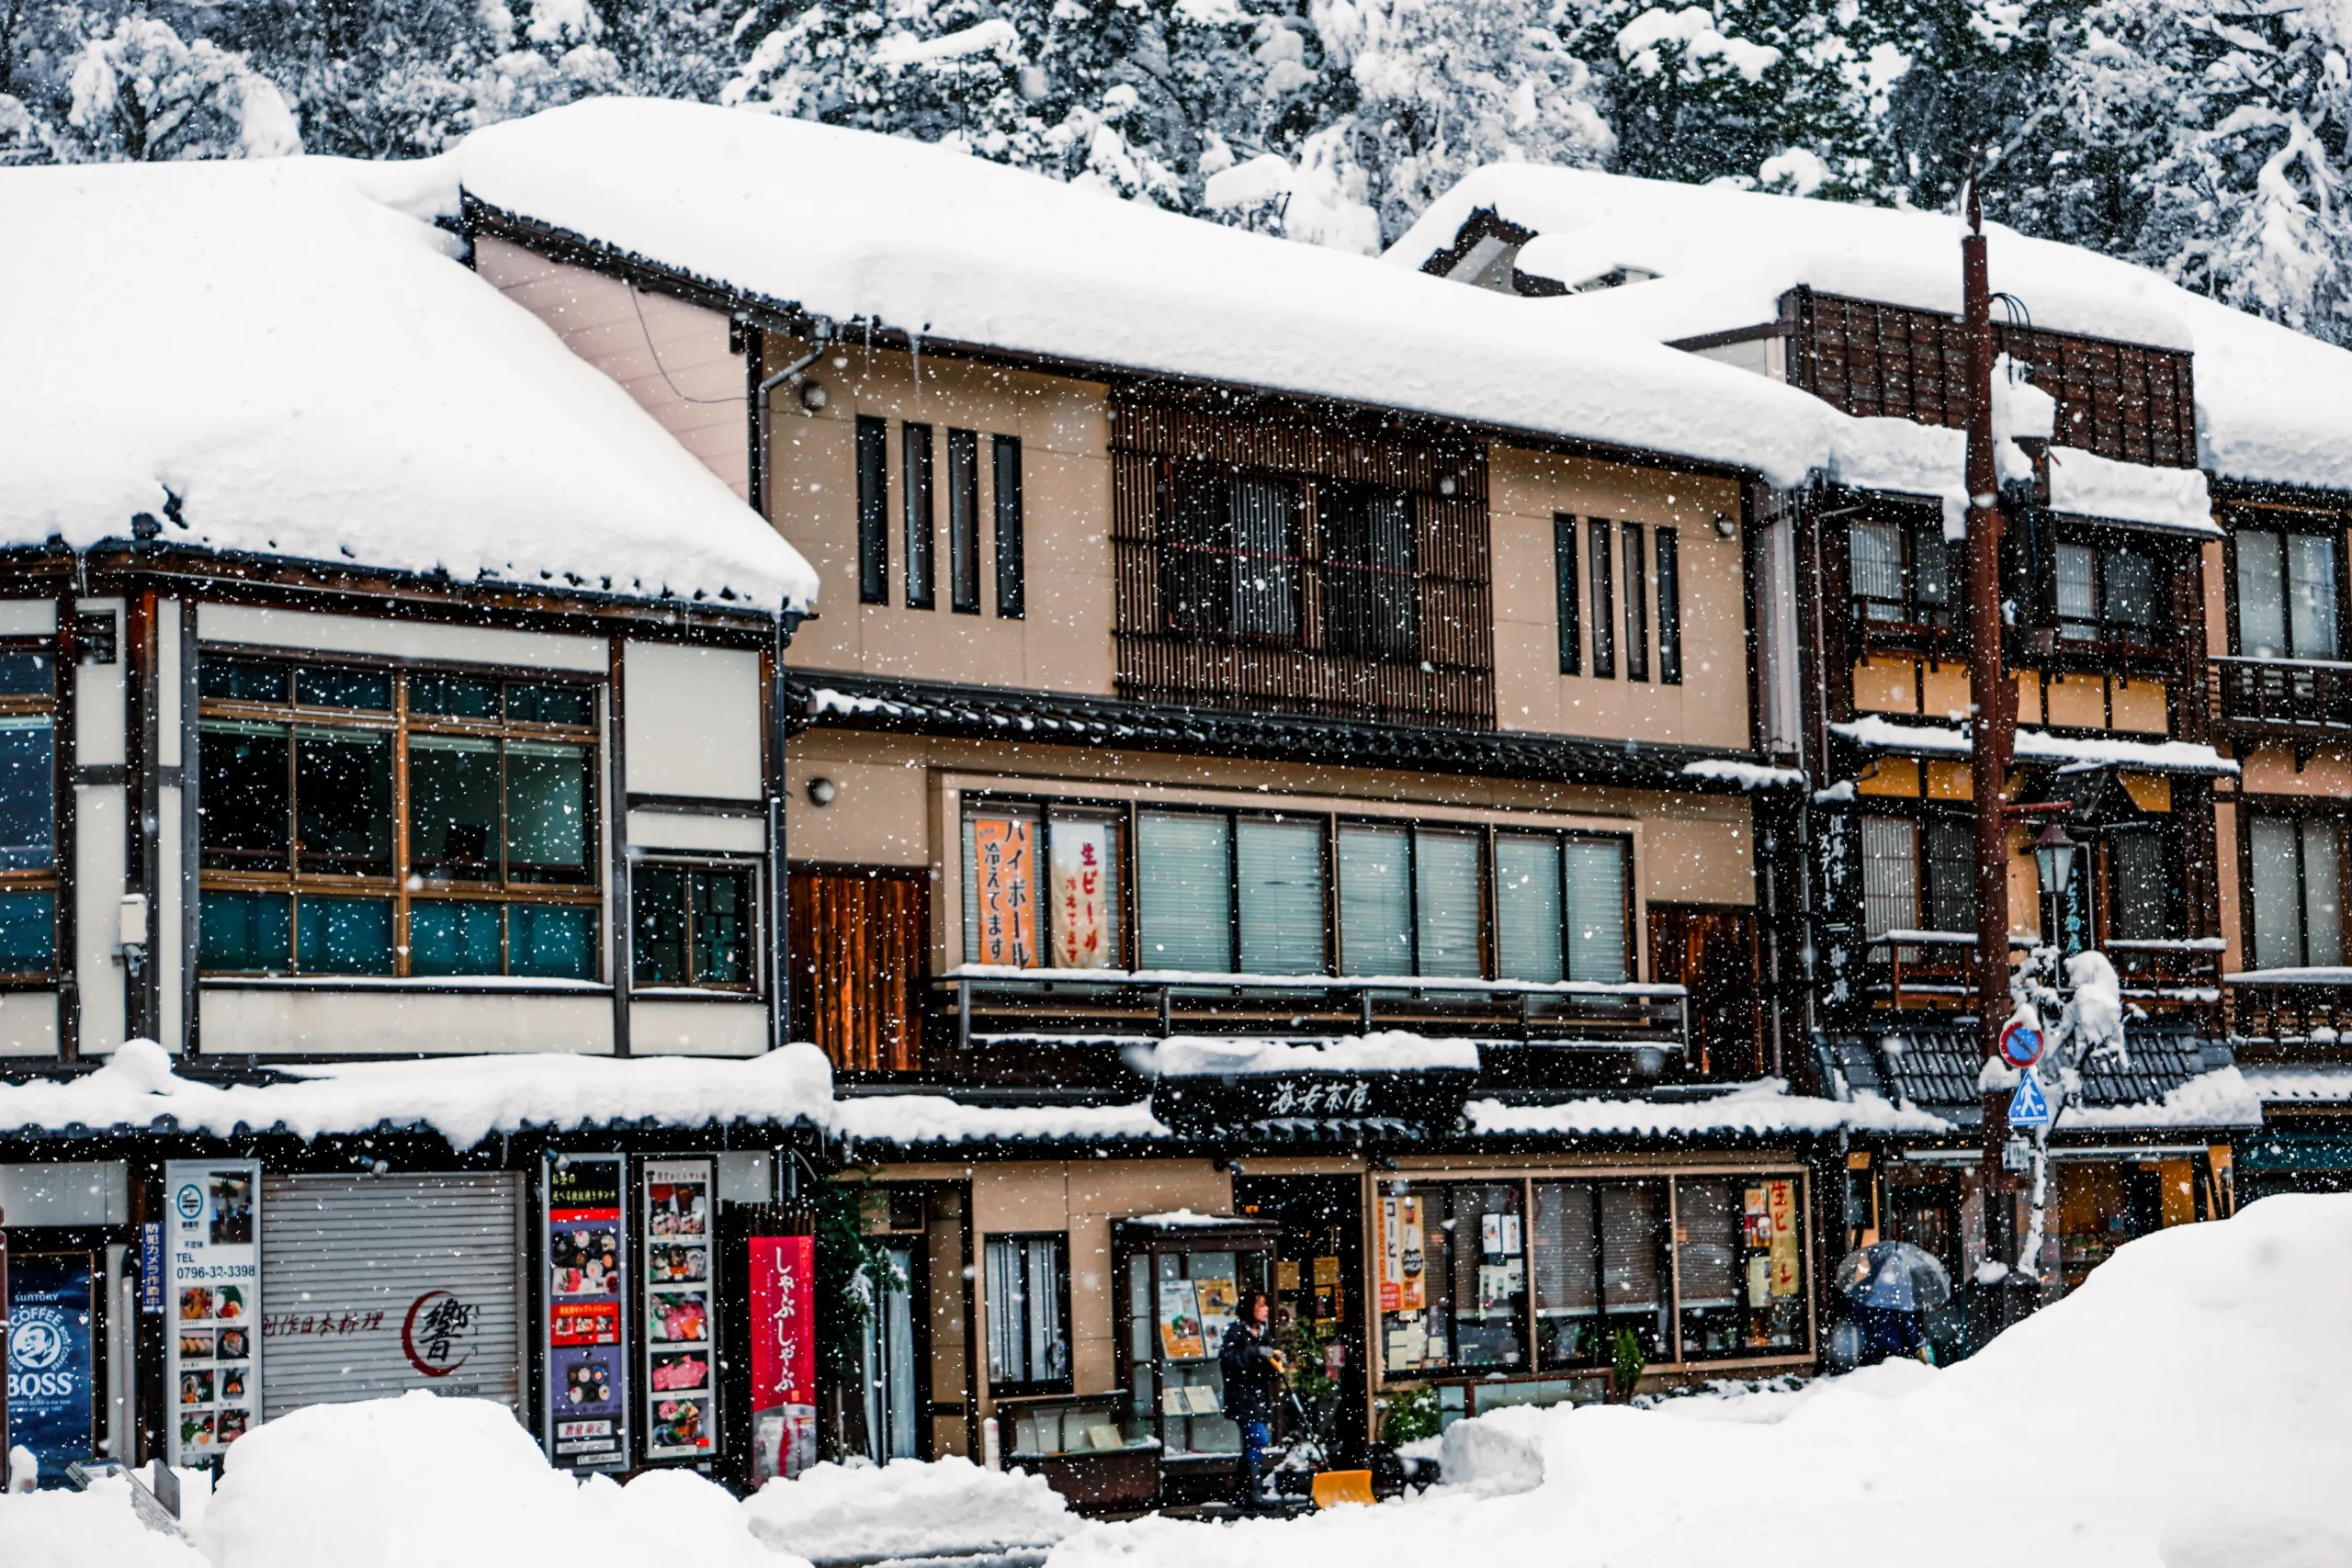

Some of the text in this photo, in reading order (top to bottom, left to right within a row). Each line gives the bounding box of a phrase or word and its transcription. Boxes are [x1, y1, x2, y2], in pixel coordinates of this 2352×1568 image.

[1819, 834, 1835, 912] ステーキ
[1829, 814, 1847, 886] 但馬牛
[1005, 821, 1030, 970] ハイボール
[1081, 841, 1098, 952] 生ビール
[145, 1223, 160, 1305] 防犯カメラ作動中
[175, 1252, 196, 1263] TEL
[1386, 1201, 1397, 1278] コーヒー
[10, 1307, 63, 1326] COFFEE
[774, 1247, 796, 1393] しゃぶしゃぶ
[7, 1371, 73, 1396] BOSS
